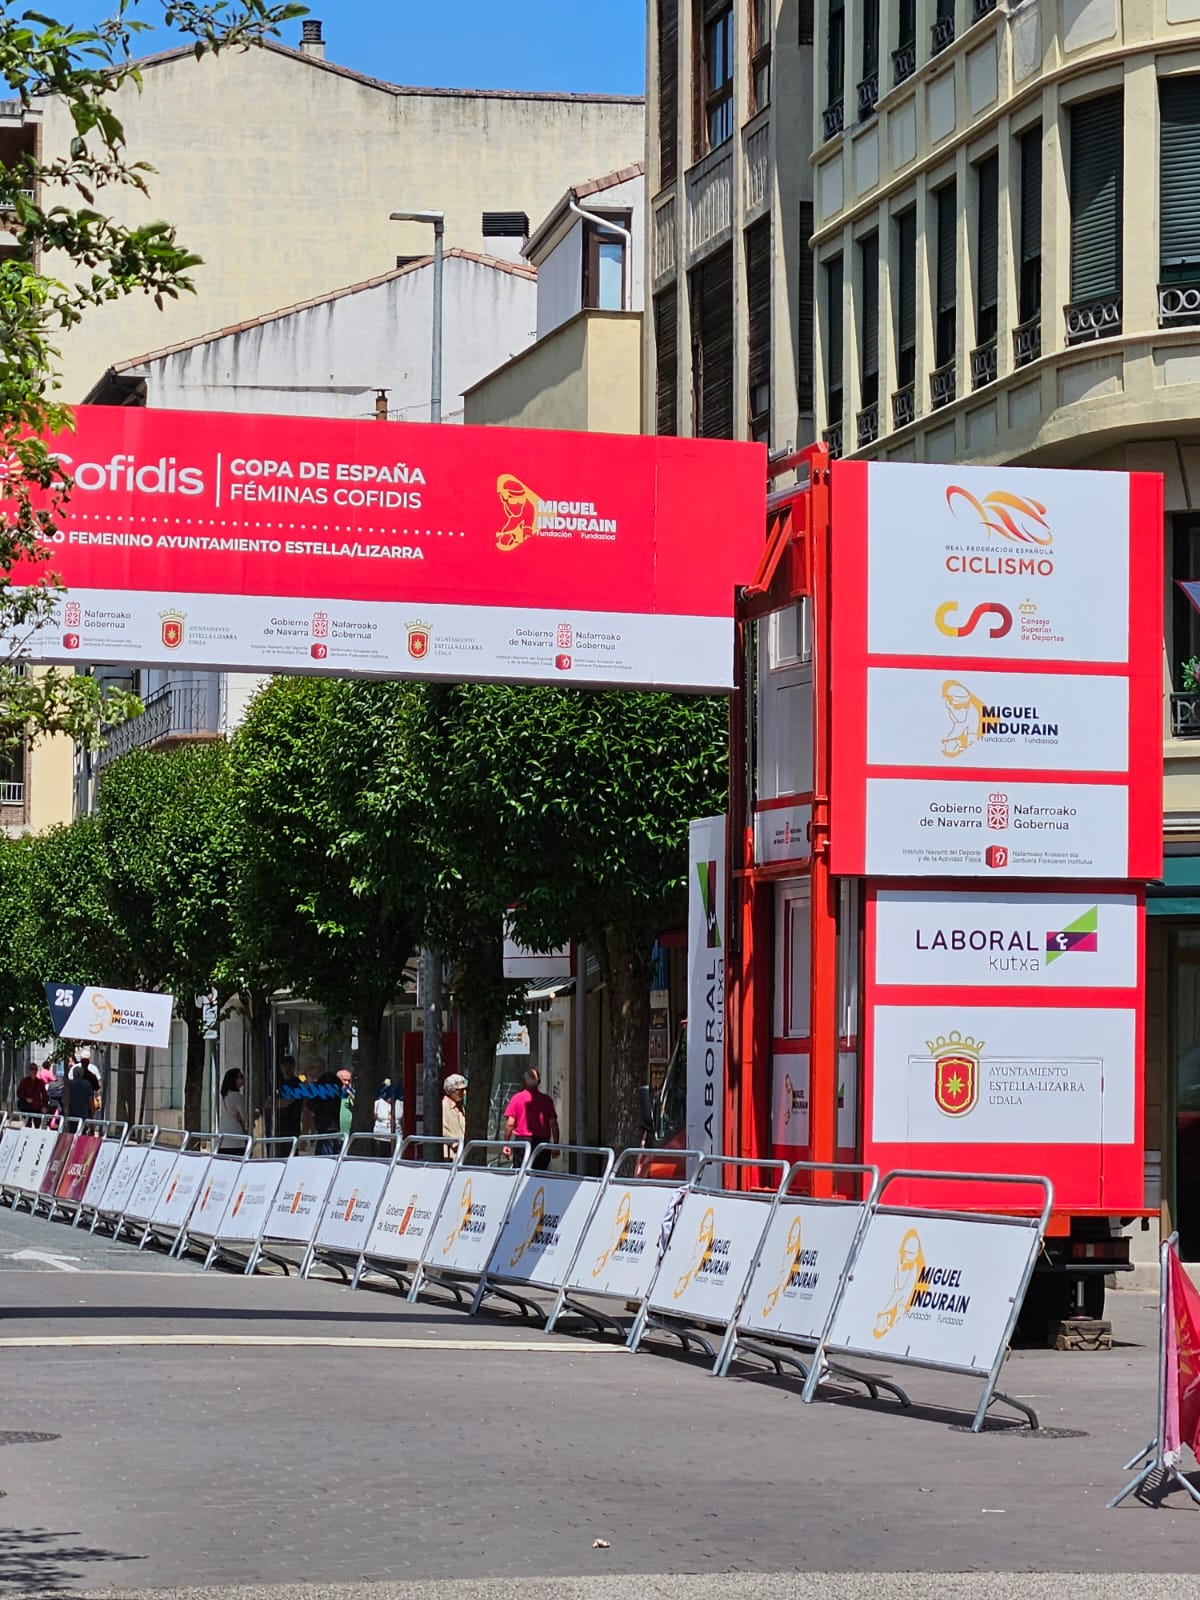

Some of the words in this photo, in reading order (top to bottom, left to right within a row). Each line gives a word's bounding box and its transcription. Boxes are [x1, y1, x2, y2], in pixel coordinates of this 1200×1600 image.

[230, 458, 293, 478] COPA
[299, 462, 330, 480] DE
[336, 463, 426, 485] ESPAÑA
[230, 481, 328, 504] FÉMINAS
[333, 488, 422, 509] COFIDIS
[537, 500, 597, 516] MIGUEL
[537, 516, 617, 532] INDURAIN
[69, 531, 152, 547] FEMENINO
[156, 535, 282, 553] AYUNTAMIENTO
[285, 541, 424, 560] ESTELLA/LIZARRA
[966, 545, 1013, 553] FEDERACIÓN
[1015, 547, 1054, 555] ESPAÑOLA
[946, 555, 1054, 576] CICLISMO
[84, 609, 131, 620] Nafarroako
[84, 619, 126, 629] Gobernua
[271, 617, 309, 627] Gobierno
[332, 620, 378, 630] Nafarroako
[1021, 617, 1050, 627] Consejo
[264, 627, 274, 636] de
[276, 628, 309, 637] Navarra
[332, 630, 372, 640] Gobernua
[516, 628, 554, 638] Gobierno
[575, 631, 622, 641] Nafarroako
[1021, 626, 1052, 635] Superior
[508, 638, 519, 647] de
[521, 639, 554, 648] Navarra
[1032, 634, 1064, 643] Deportes
[575, 641, 616, 650] Gobernua
[982, 705, 1039, 719] MIGUEL
[982, 722, 1059, 736] INDURAIN
[929, 802, 982, 814] Gobierno
[1013, 805, 1077, 817] Nafarroako
[920, 817, 934, 827] de
[937, 818, 982, 828] Navarra
[1013, 819, 1070, 830] Gobernua
[916, 929, 1039, 951] LABORAL
[989, 955, 1040, 971] kutxa
[54, 988, 73, 1007] 25
[112, 1008, 144, 1018] MIGUEL
[112, 1017, 154, 1028] INDURAIN
[704, 959, 716, 1166] LABORAL
[989, 1067, 1068, 1077] AYUNTAMIENTO
[989, 1081, 1085, 1092] ESTELLA-LIZARRA
[989, 1095, 1023, 1105] UDALA
[540, 1213, 560, 1228] MIGUEL
[624, 1220, 647, 1235] MIGUEL
[616, 1238, 647, 1255] INDURAIN
[708, 1238, 731, 1255] MIGUEL
[797, 1249, 819, 1266] MIGUEL
[700, 1257, 731, 1276] INDURAIN
[788, 1270, 820, 1290] INDURAIN
[918, 1266, 962, 1288] MIGUEL
[910, 1289, 970, 1314] INDURAIN
